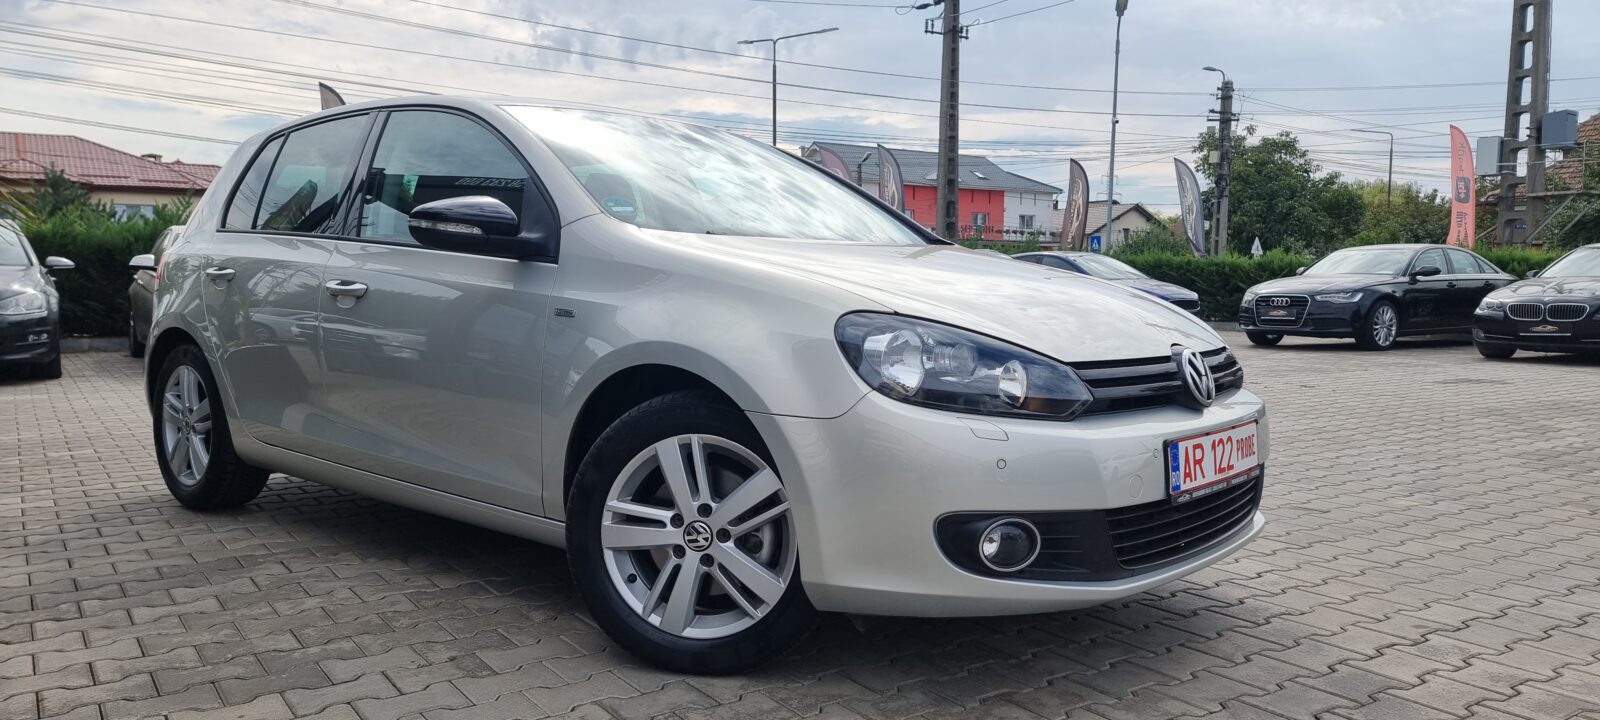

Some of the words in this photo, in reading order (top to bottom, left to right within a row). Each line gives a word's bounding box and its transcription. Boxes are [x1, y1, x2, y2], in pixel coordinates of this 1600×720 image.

[1183, 443, 1206, 484] AR
[1210, 435, 1235, 476] 122
[1236, 434, 1255, 461] PROBE
[1171, 471, 1180, 487] RO
